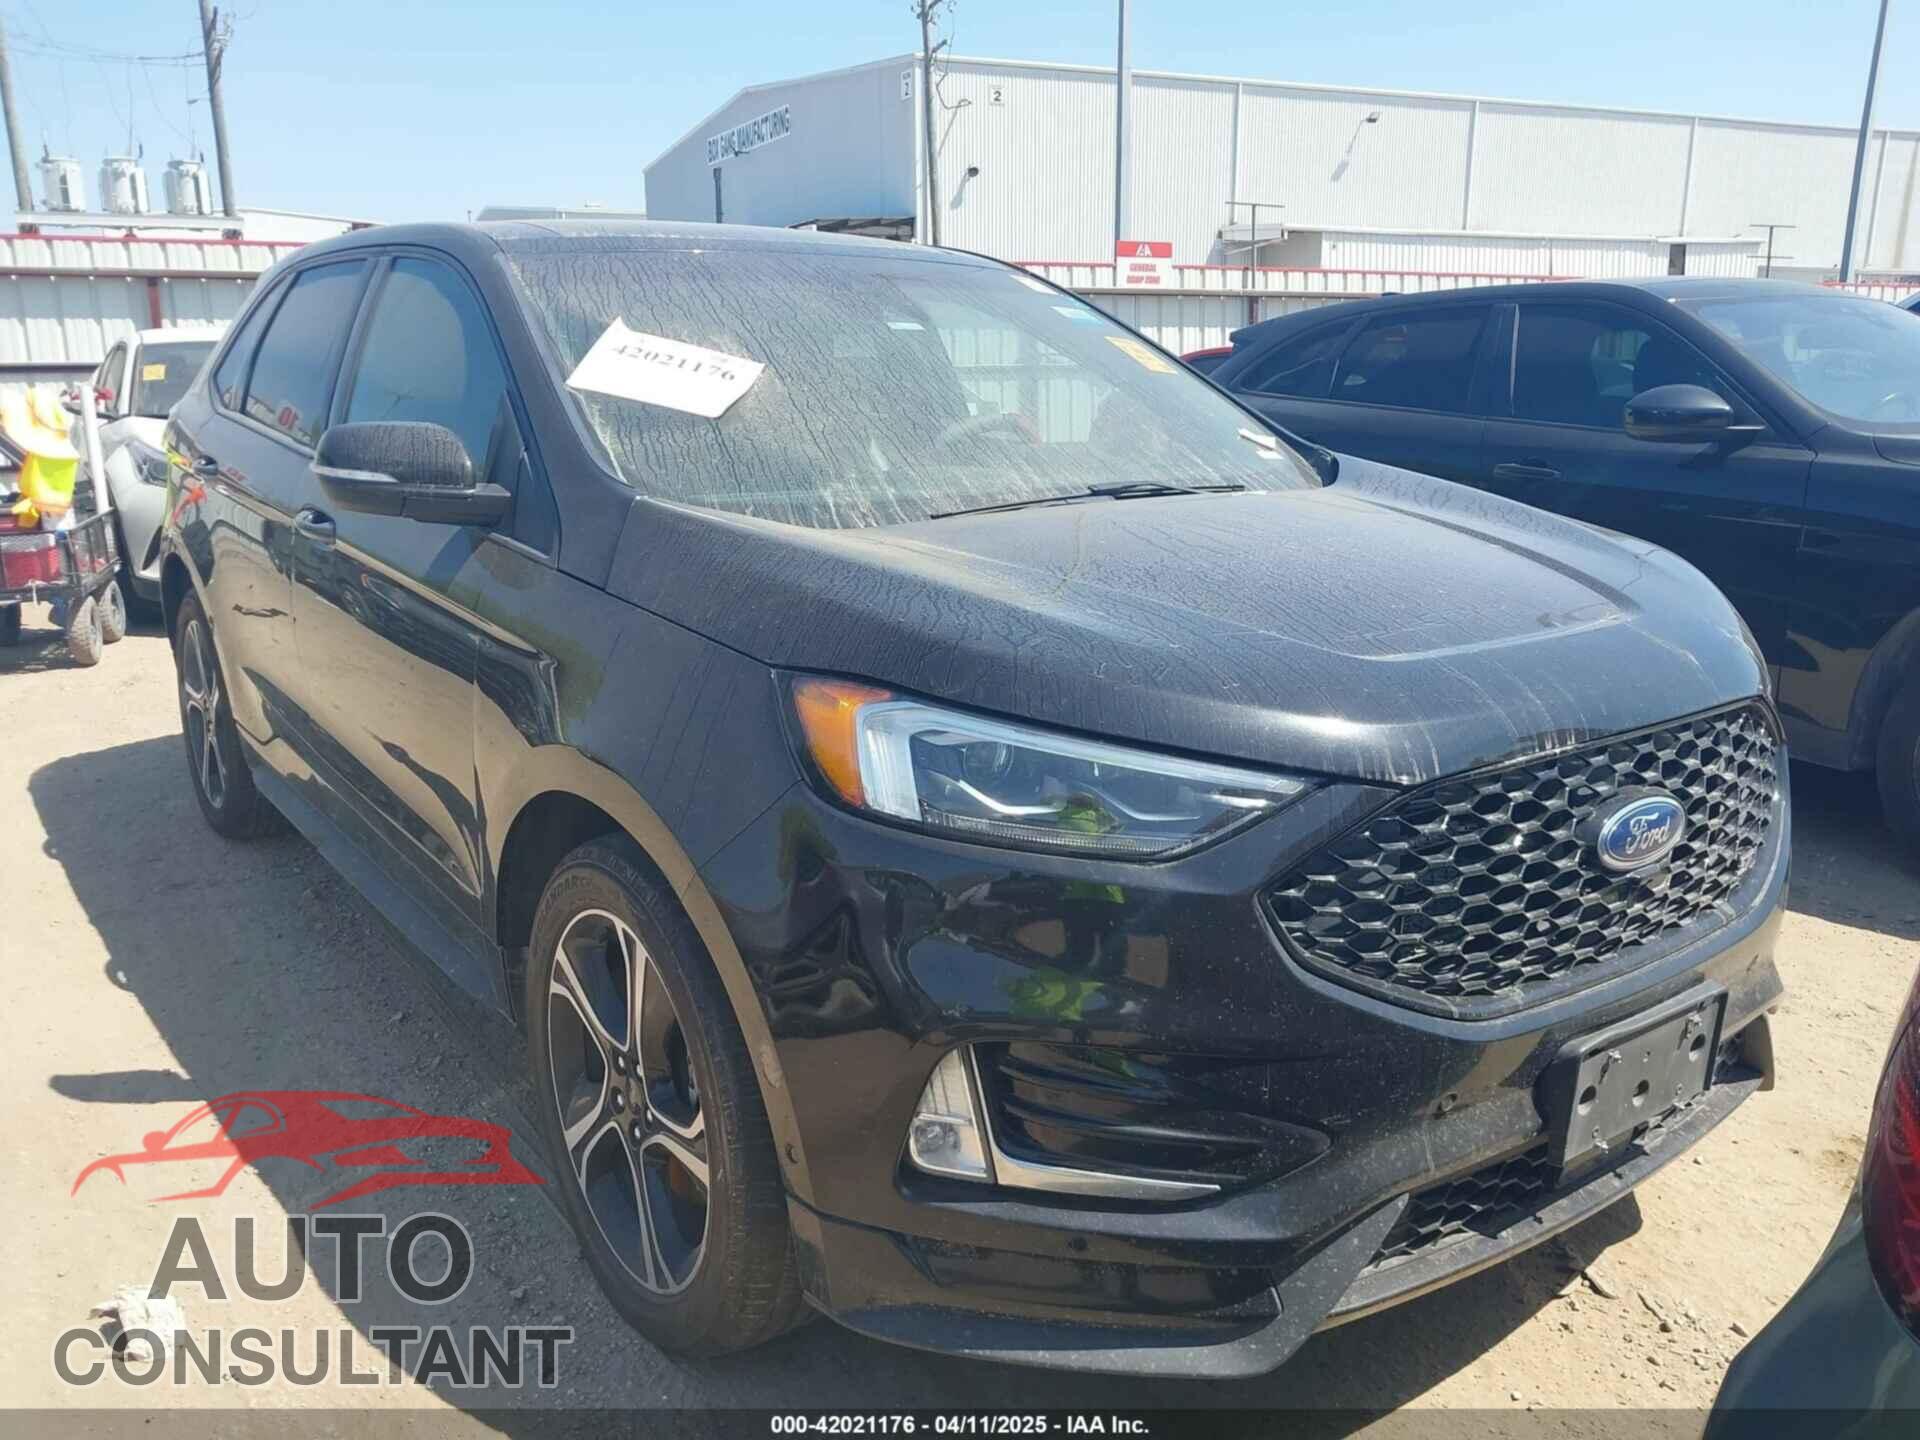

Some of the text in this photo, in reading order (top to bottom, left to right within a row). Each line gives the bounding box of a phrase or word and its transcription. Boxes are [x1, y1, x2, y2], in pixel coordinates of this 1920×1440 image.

[993, 90, 1002, 102] 2
[737, 106, 790, 151] MANUFACTURING
[611, 344, 736, 382] 42021176
[1625, 811, 1671, 855] Ford
